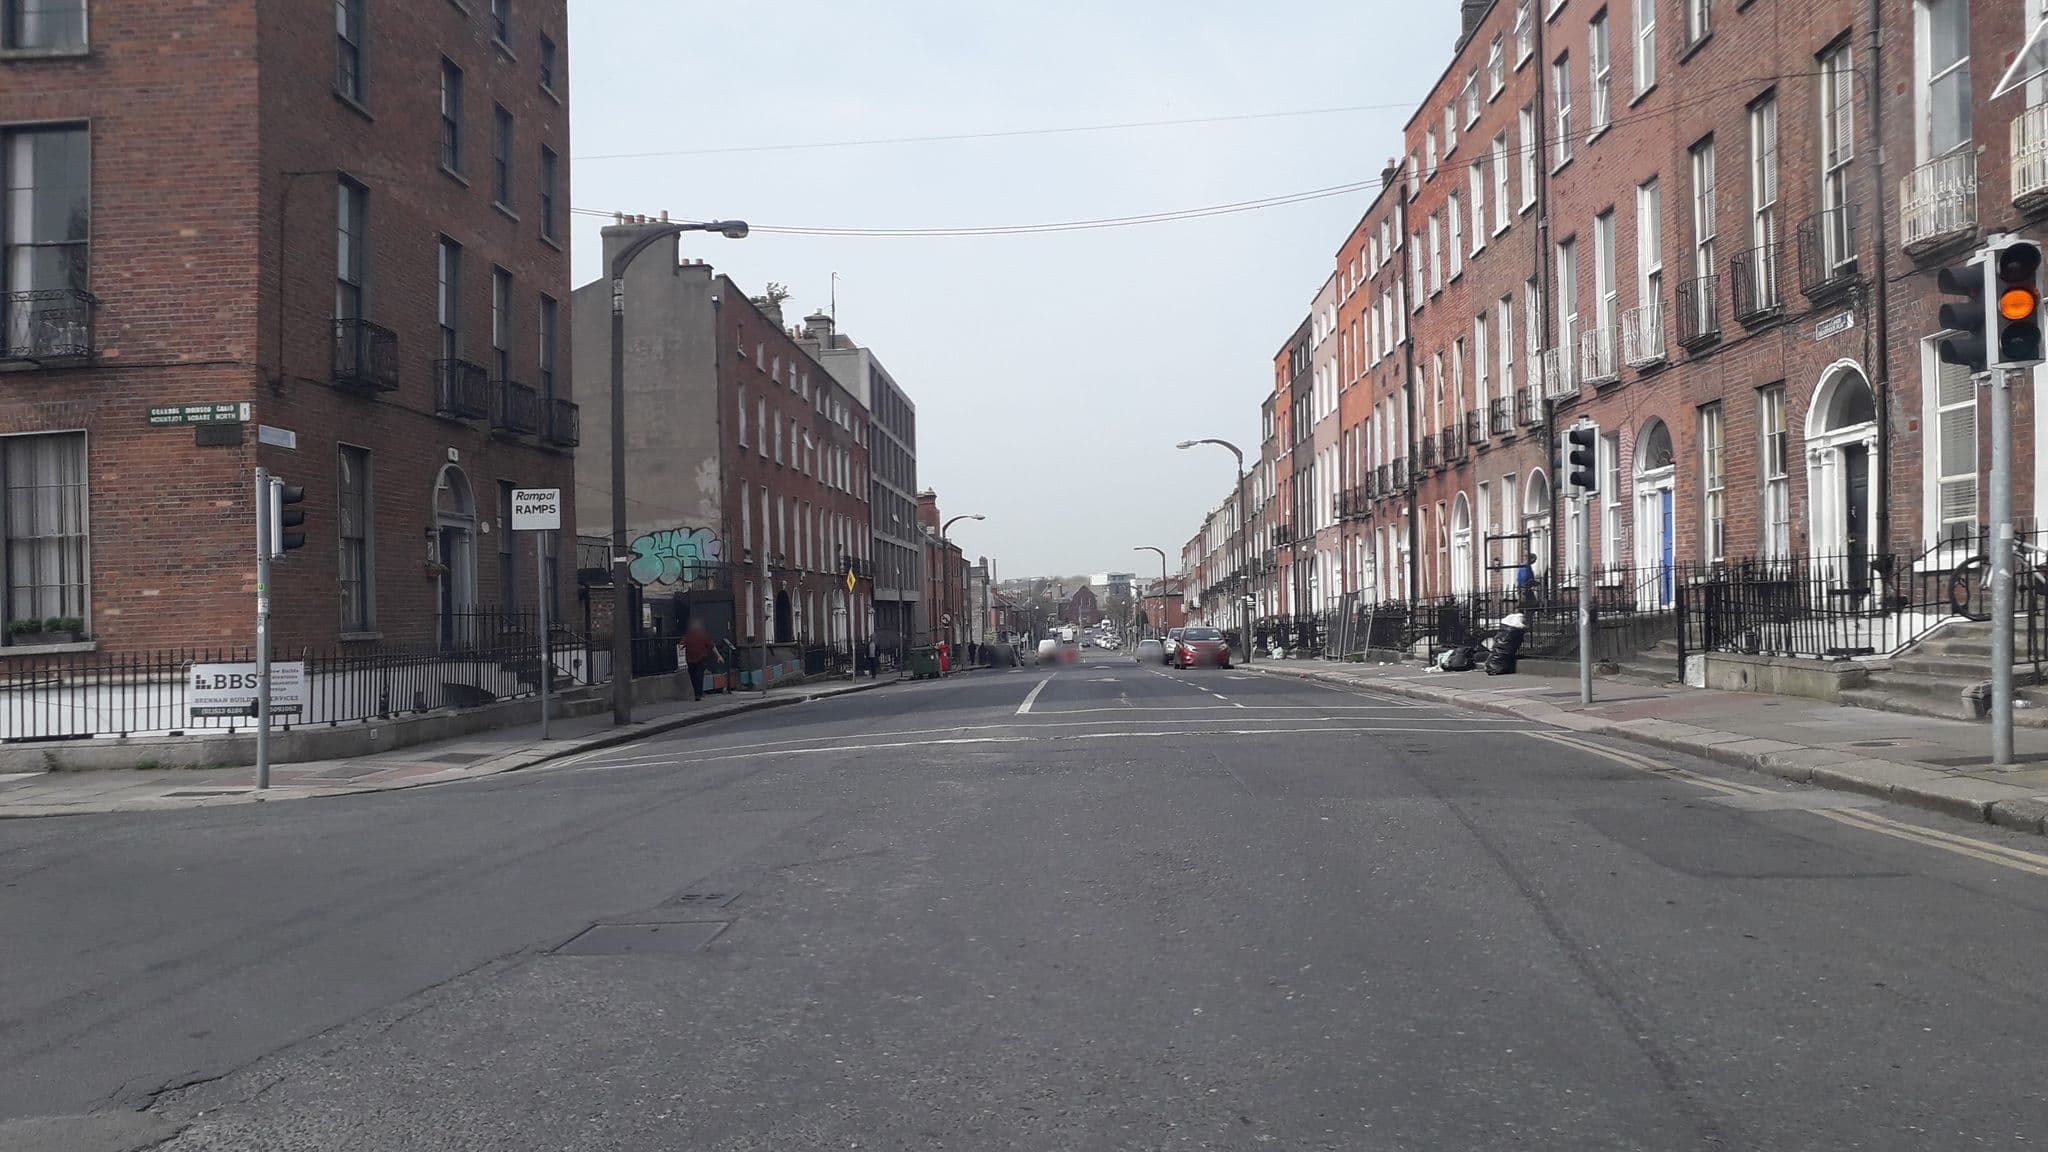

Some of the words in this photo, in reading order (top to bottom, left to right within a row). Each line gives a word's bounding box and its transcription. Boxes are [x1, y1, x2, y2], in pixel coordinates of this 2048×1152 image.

[187, 414, 210, 422] SQUARE
[215, 412, 236, 420] NORTH
[515, 504, 556, 514] RAMPS
[213, 673, 258, 690] BBS
